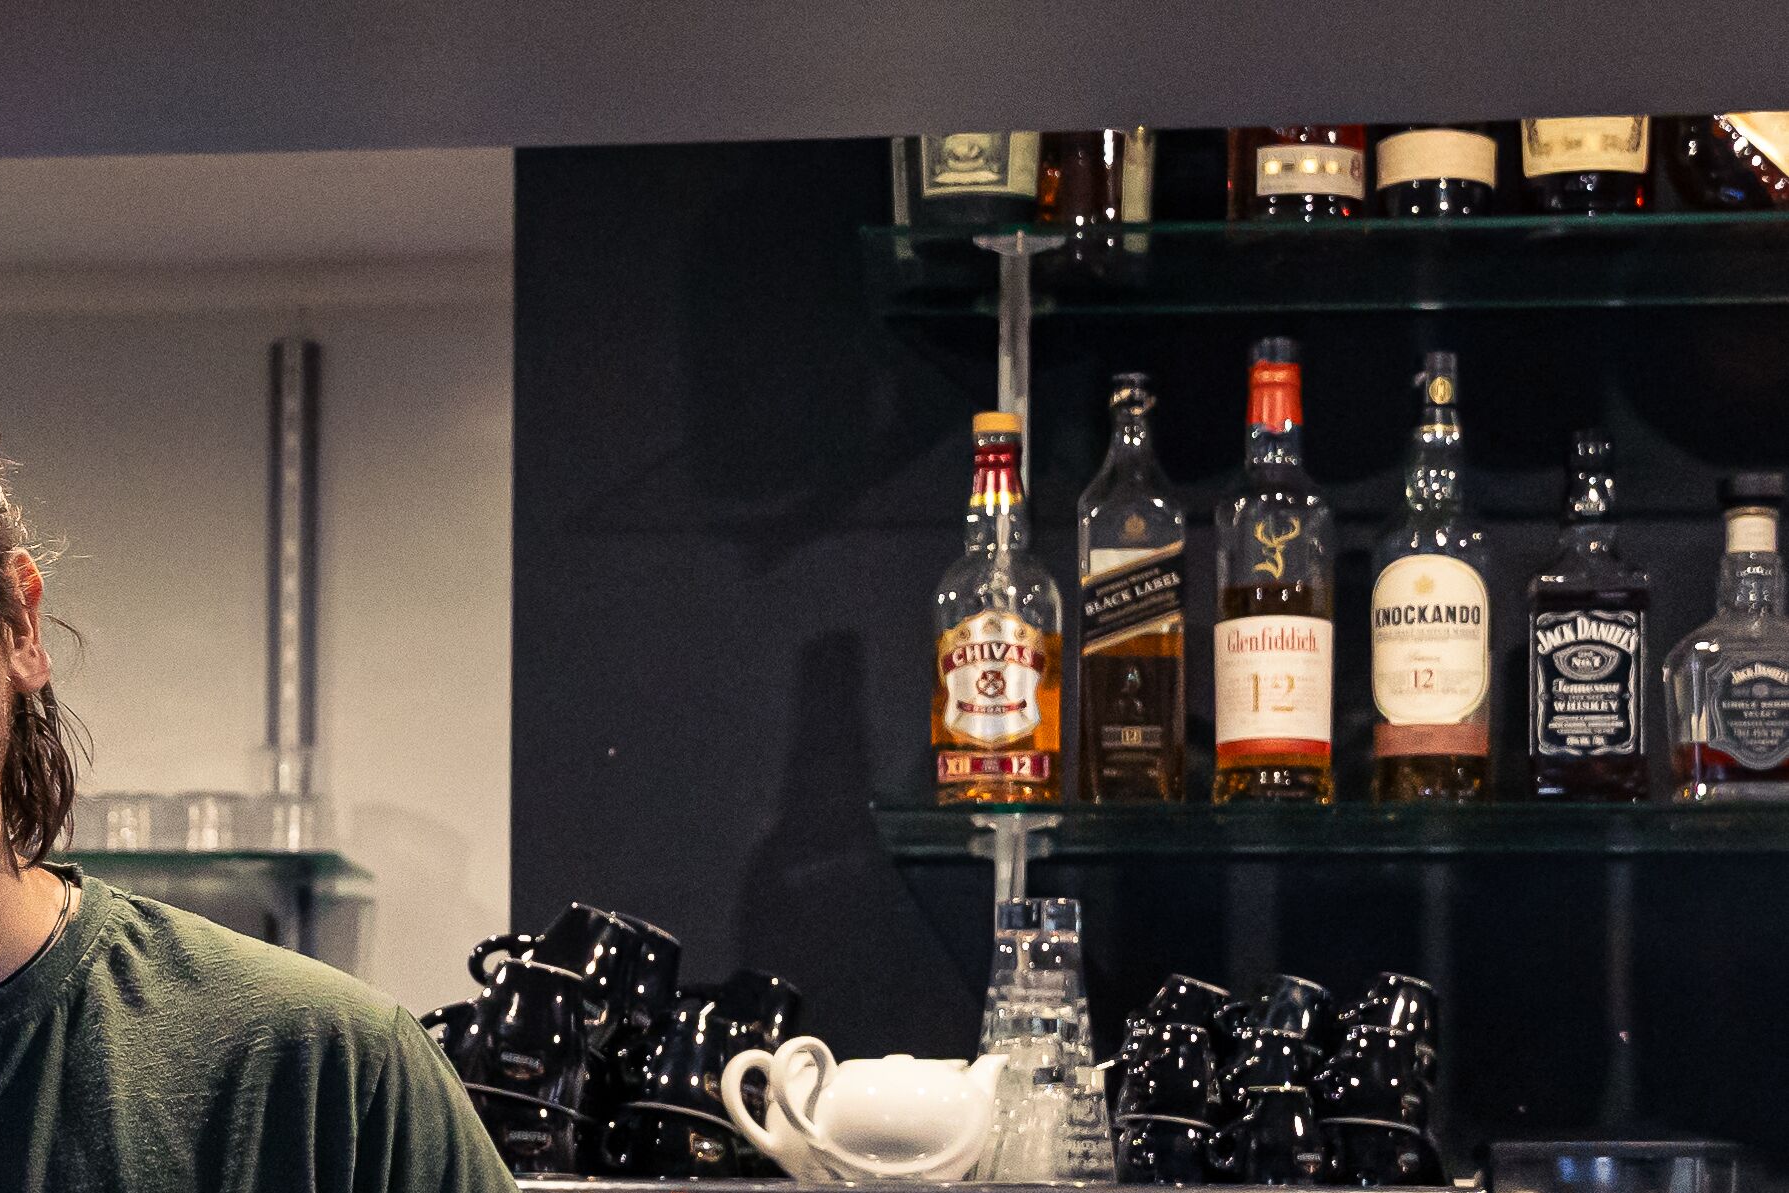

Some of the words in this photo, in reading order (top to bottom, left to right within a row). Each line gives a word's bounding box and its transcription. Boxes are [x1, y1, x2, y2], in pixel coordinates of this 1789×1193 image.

[1085, 591, 1131, 617] BLACK
[1134, 571, 1182, 598] LABEL
[1375, 603, 1481, 628] KNOCKANDO
[1227, 626, 1319, 652] Glenfiddich
[1536, 622, 1575, 655] JACK
[951, 642, 1034, 667] CHIVAS
[1412, 668, 1434, 689] 12
[1251, 672, 1296, 713] 12
[1011, 755, 1032, 775] 12
